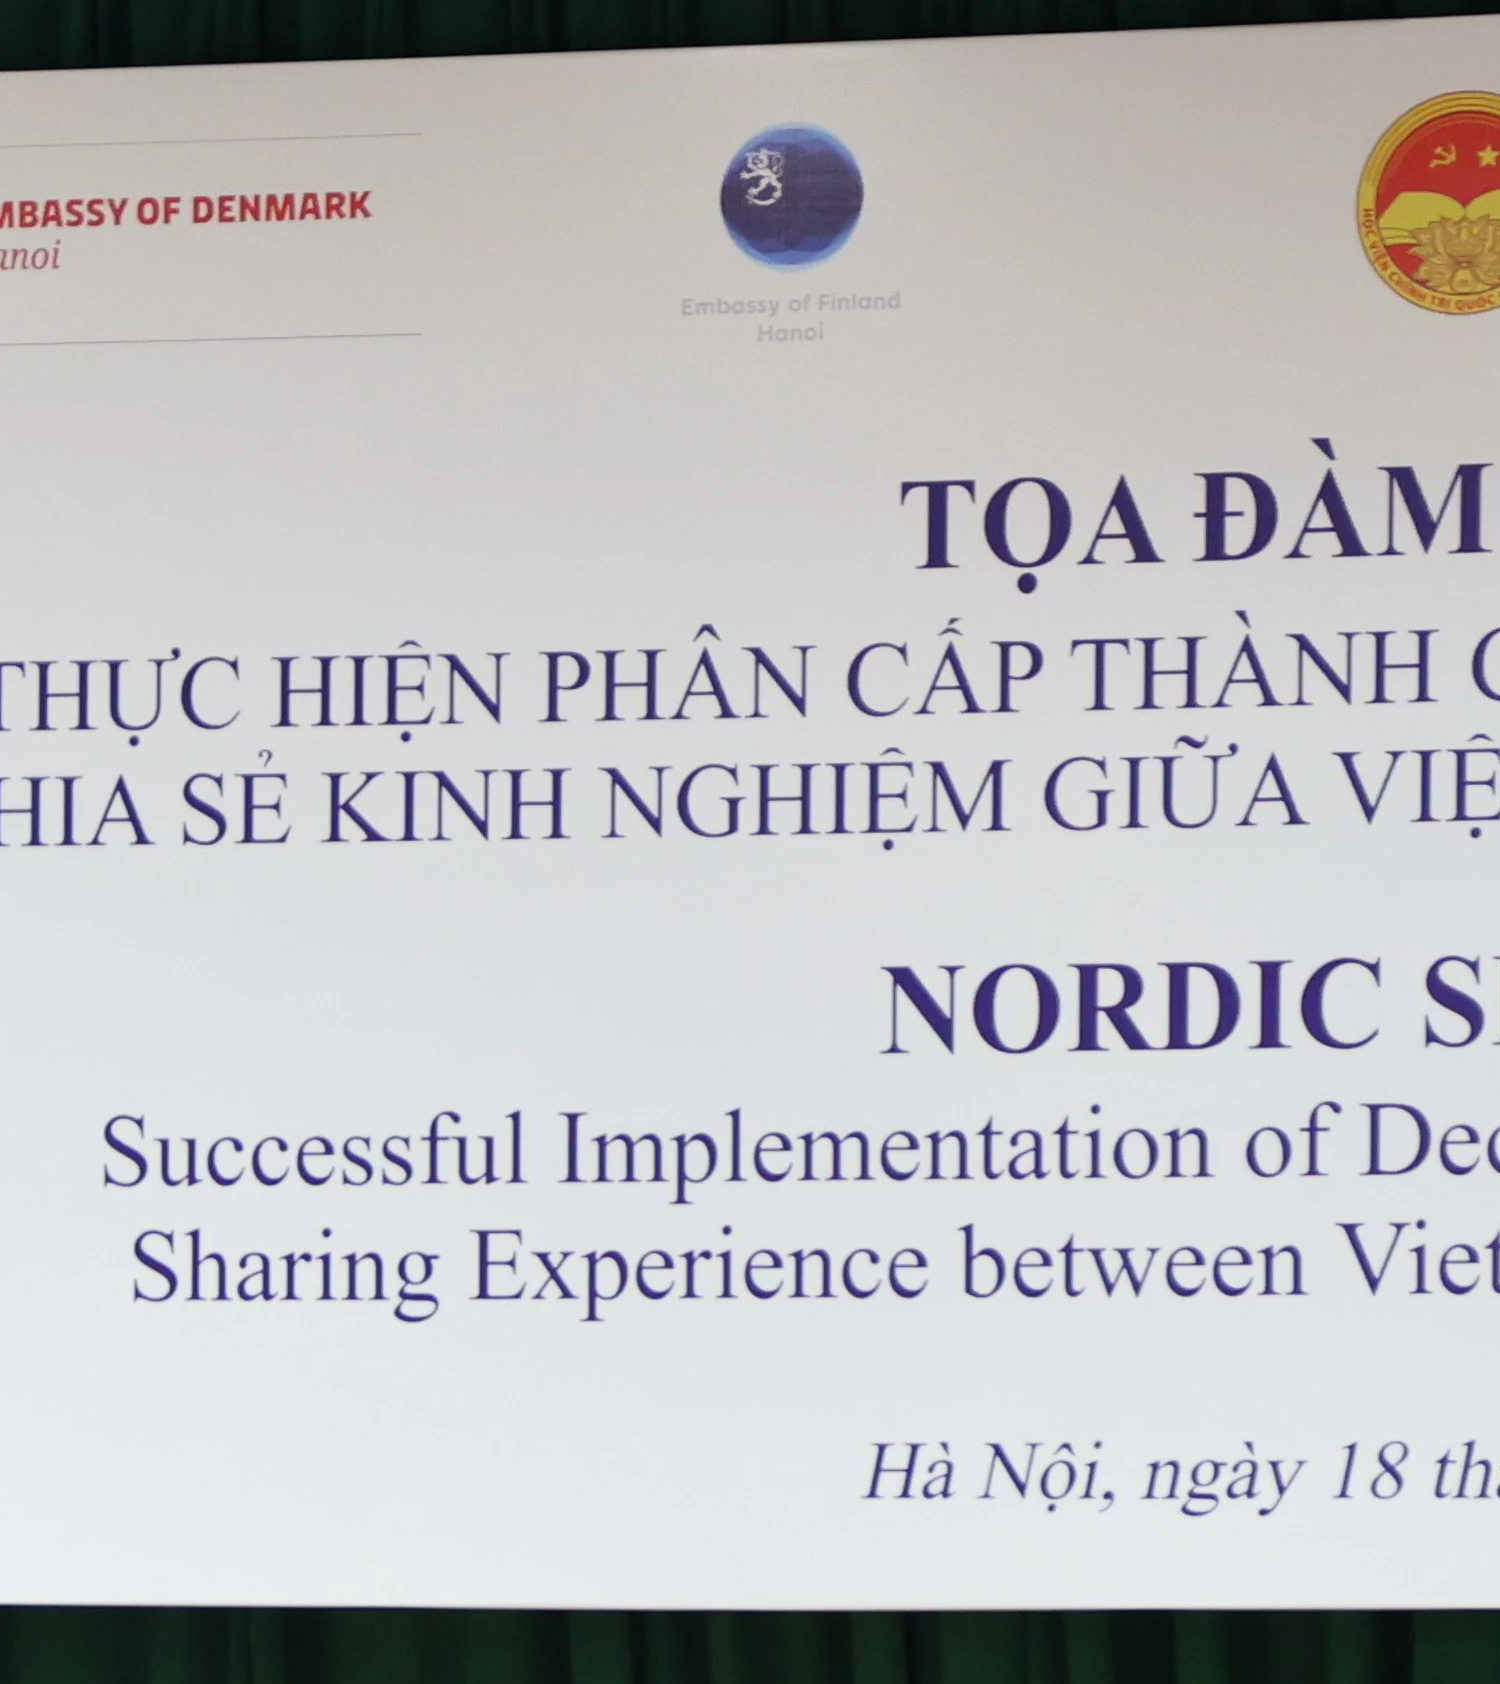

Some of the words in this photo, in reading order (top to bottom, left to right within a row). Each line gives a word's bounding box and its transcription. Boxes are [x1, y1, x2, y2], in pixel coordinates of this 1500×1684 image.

[135, 195, 182, 227] OF
[191, 189, 373, 225] DENMARK
[679, 296, 782, 320] Embassy
[785, 291, 813, 315] of
[814, 289, 903, 314] Finland
[755, 318, 826, 345] Hanoi
[899, 473, 1166, 596] TỌA
[1192, 436, 1494, 563] ĐÀM
[270, 639, 511, 744] HIỆN
[538, 622, 816, 724] PHÂN
[845, 616, 1045, 719] CẤP
[1069, 608, 1440, 712] THÀNH
[181, 748, 292, 847] SẺ
[321, 767, 570, 844] KINH
[598, 746, 1012, 853] NGHIỆM
[1042, 734, 1311, 833] GIỮA
[879, 956, 1382, 1056] NORDIC
[102, 1109, 527, 1189] Successful
[558, 1102, 1214, 1206] Implementation
[1244, 1099, 1343, 1180] of
[132, 1226, 441, 1324] Sharing
[469, 1223, 929, 1323] Experience
[957, 1222, 1308, 1300] between
[864, 1440, 955, 1501] Hà
[979, 1439, 1116, 1514] Nội,
[1141, 1440, 1306, 1518] ngày
[1333, 1439, 1410, 1501] 18
